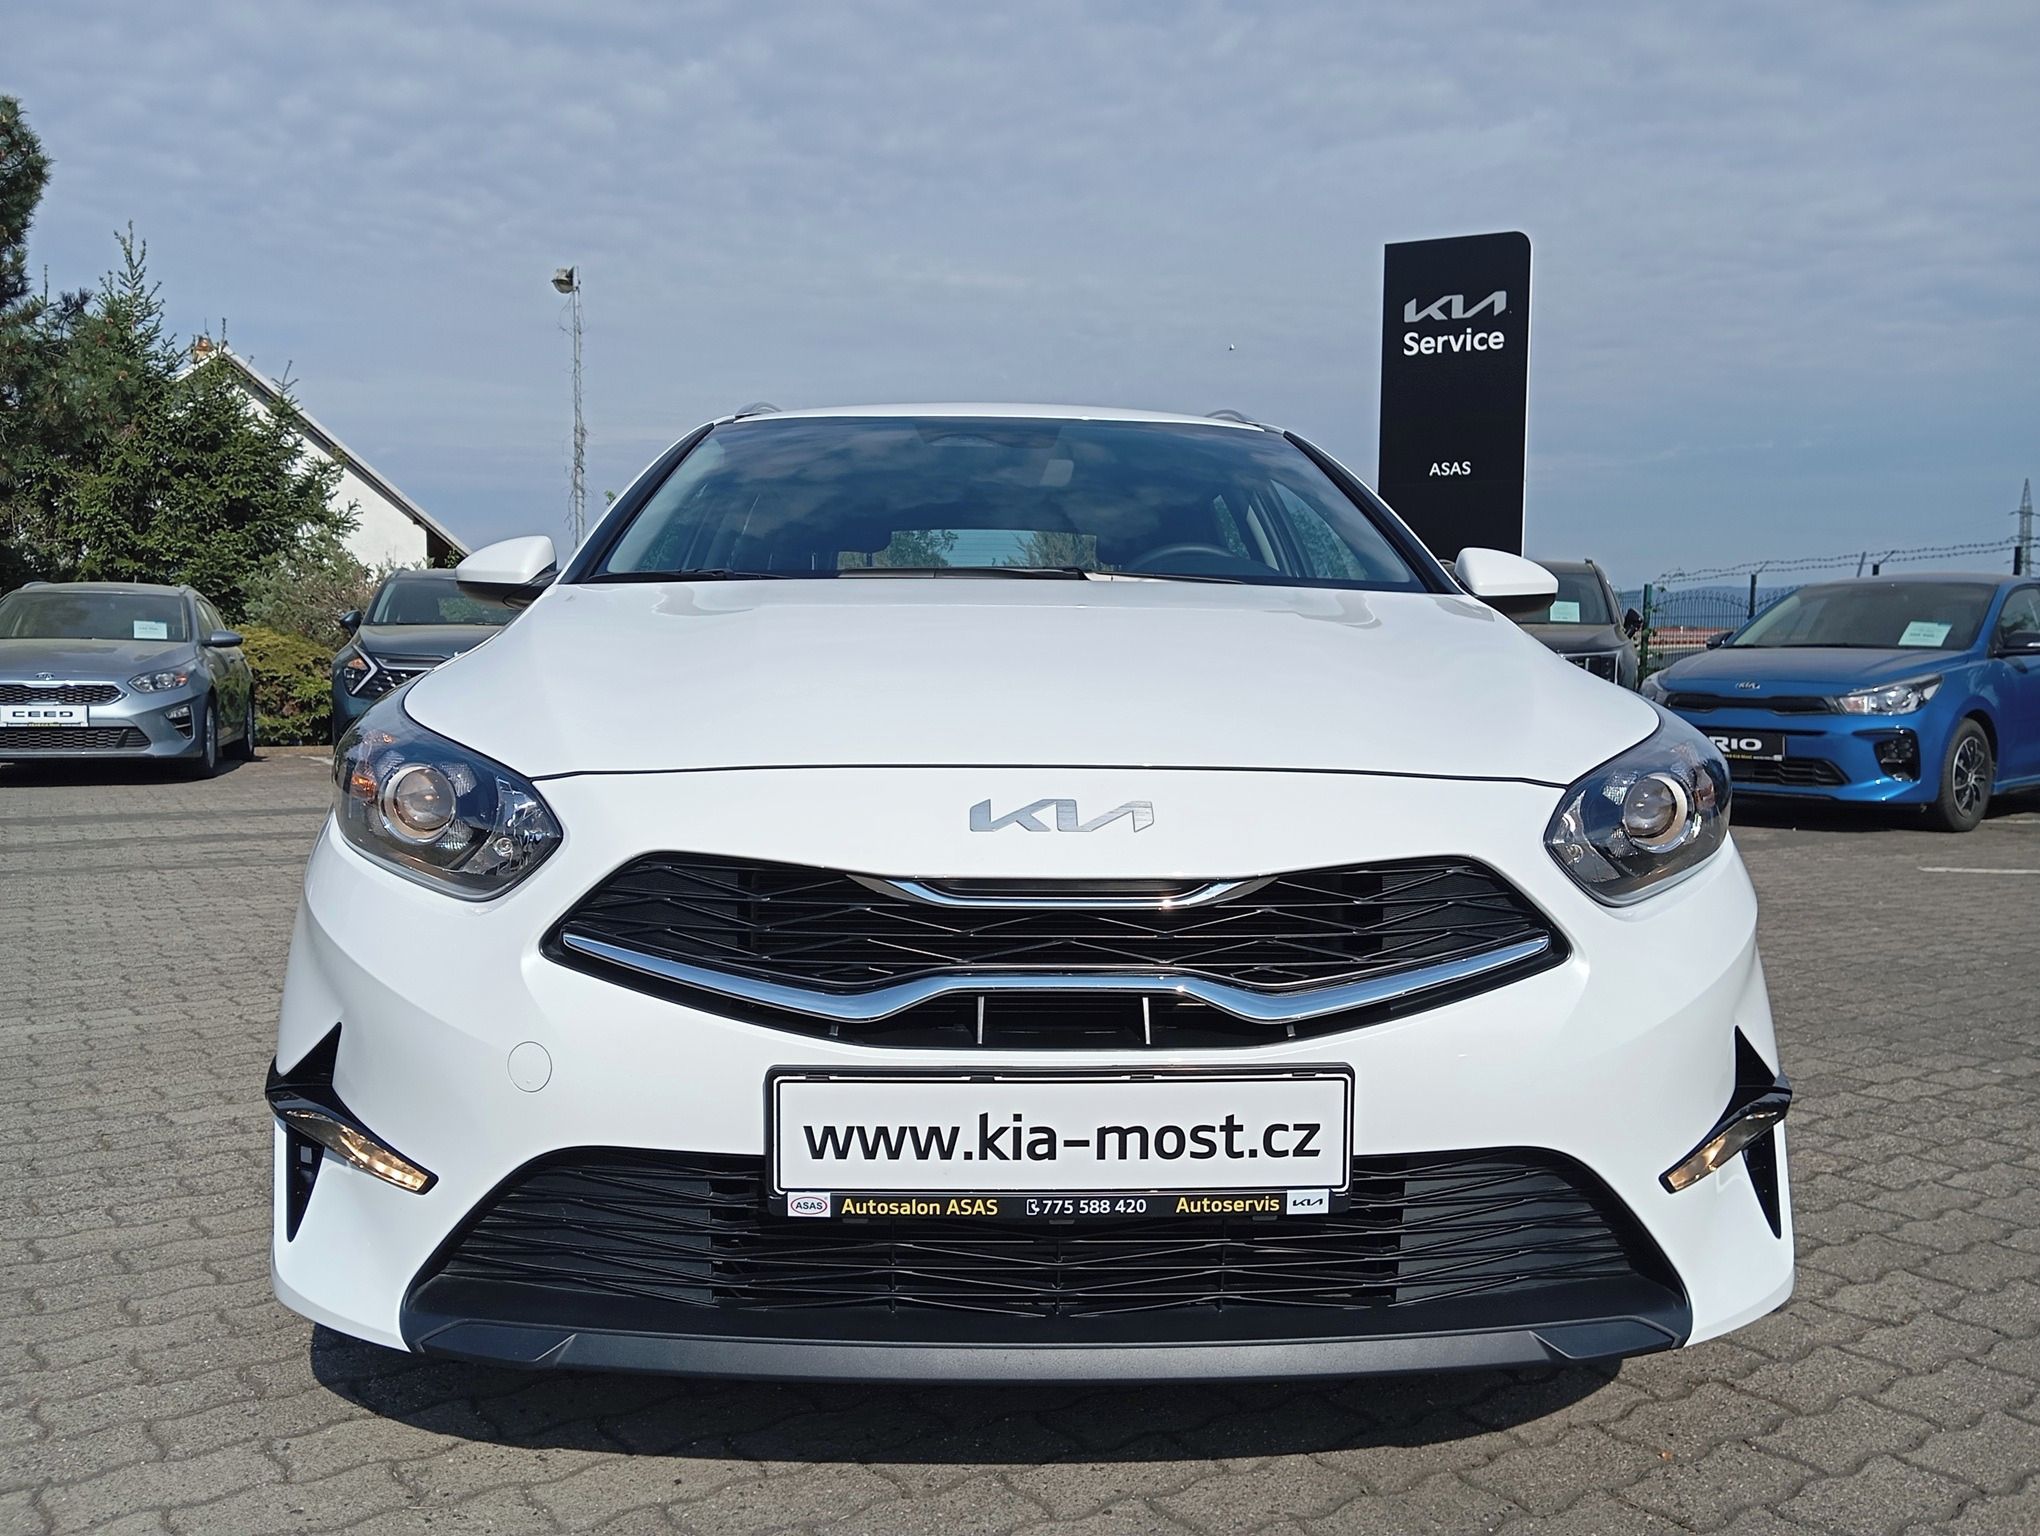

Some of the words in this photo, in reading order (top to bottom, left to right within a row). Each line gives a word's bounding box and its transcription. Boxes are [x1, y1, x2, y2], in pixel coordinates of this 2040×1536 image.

[1403, 328, 1505, 356] Service
[1429, 461, 1471, 477] ASAS
[1708, 736, 1762, 752] RIO
[802, 1111, 1322, 1162] www.kia-most.cz
[795, 1201, 823, 1210] ASAS
[841, 1198, 941, 1215] Autosalon
[945, 1199, 999, 1216] ASAS
[1042, 1200, 1073, 1215] 775
[1079, 1199, 1110, 1214] 588
[1116, 1198, 1146, 1213] 420
[1175, 1195, 1280, 1213] Autoservis
